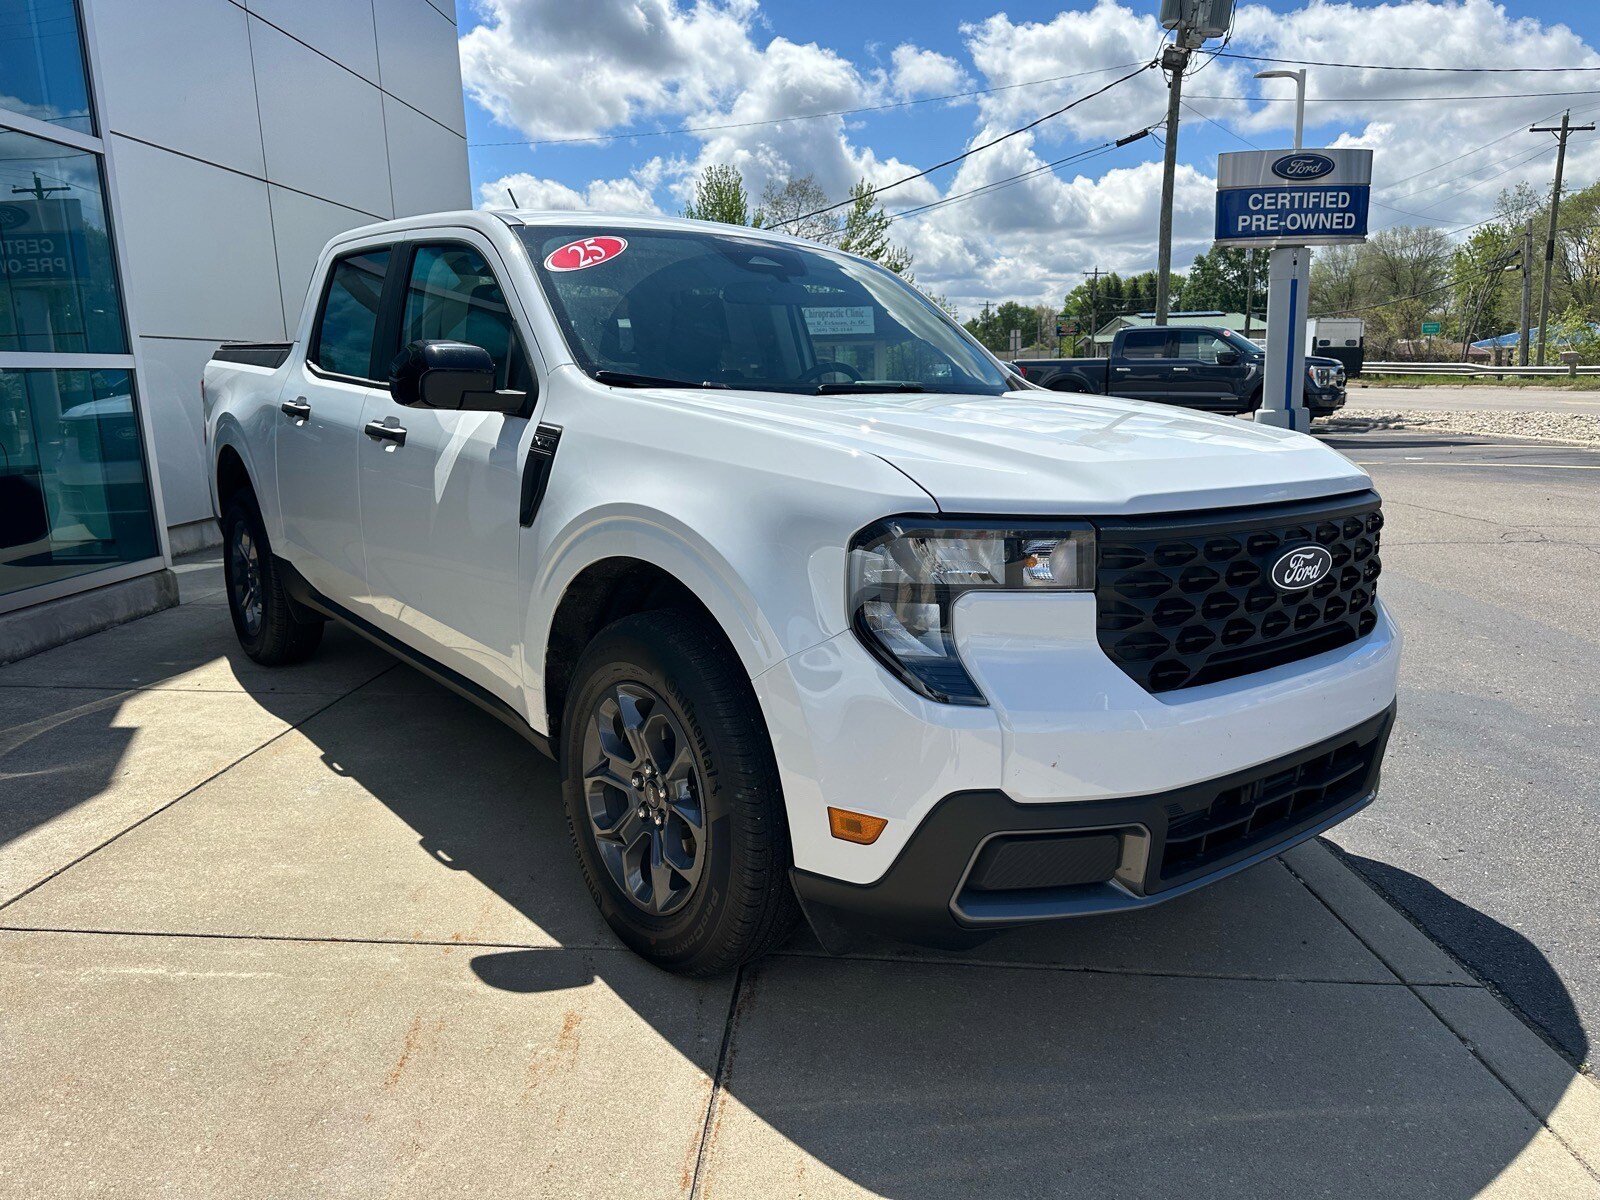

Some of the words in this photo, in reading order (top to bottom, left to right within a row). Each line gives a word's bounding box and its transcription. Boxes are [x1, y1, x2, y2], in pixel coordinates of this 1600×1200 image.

[1287, 159, 1321, 174] Ford
[1248, 192, 1351, 210] CERTIFIED
[1237, 213, 1356, 232] PRE-OWNED
[567, 239, 606, 268] 25
[803, 308, 844, 321] Chiropractic
[845, 308, 864, 318] Clinic
[1284, 553, 1323, 584] Ford
[664, 675, 719, 778] Continental
